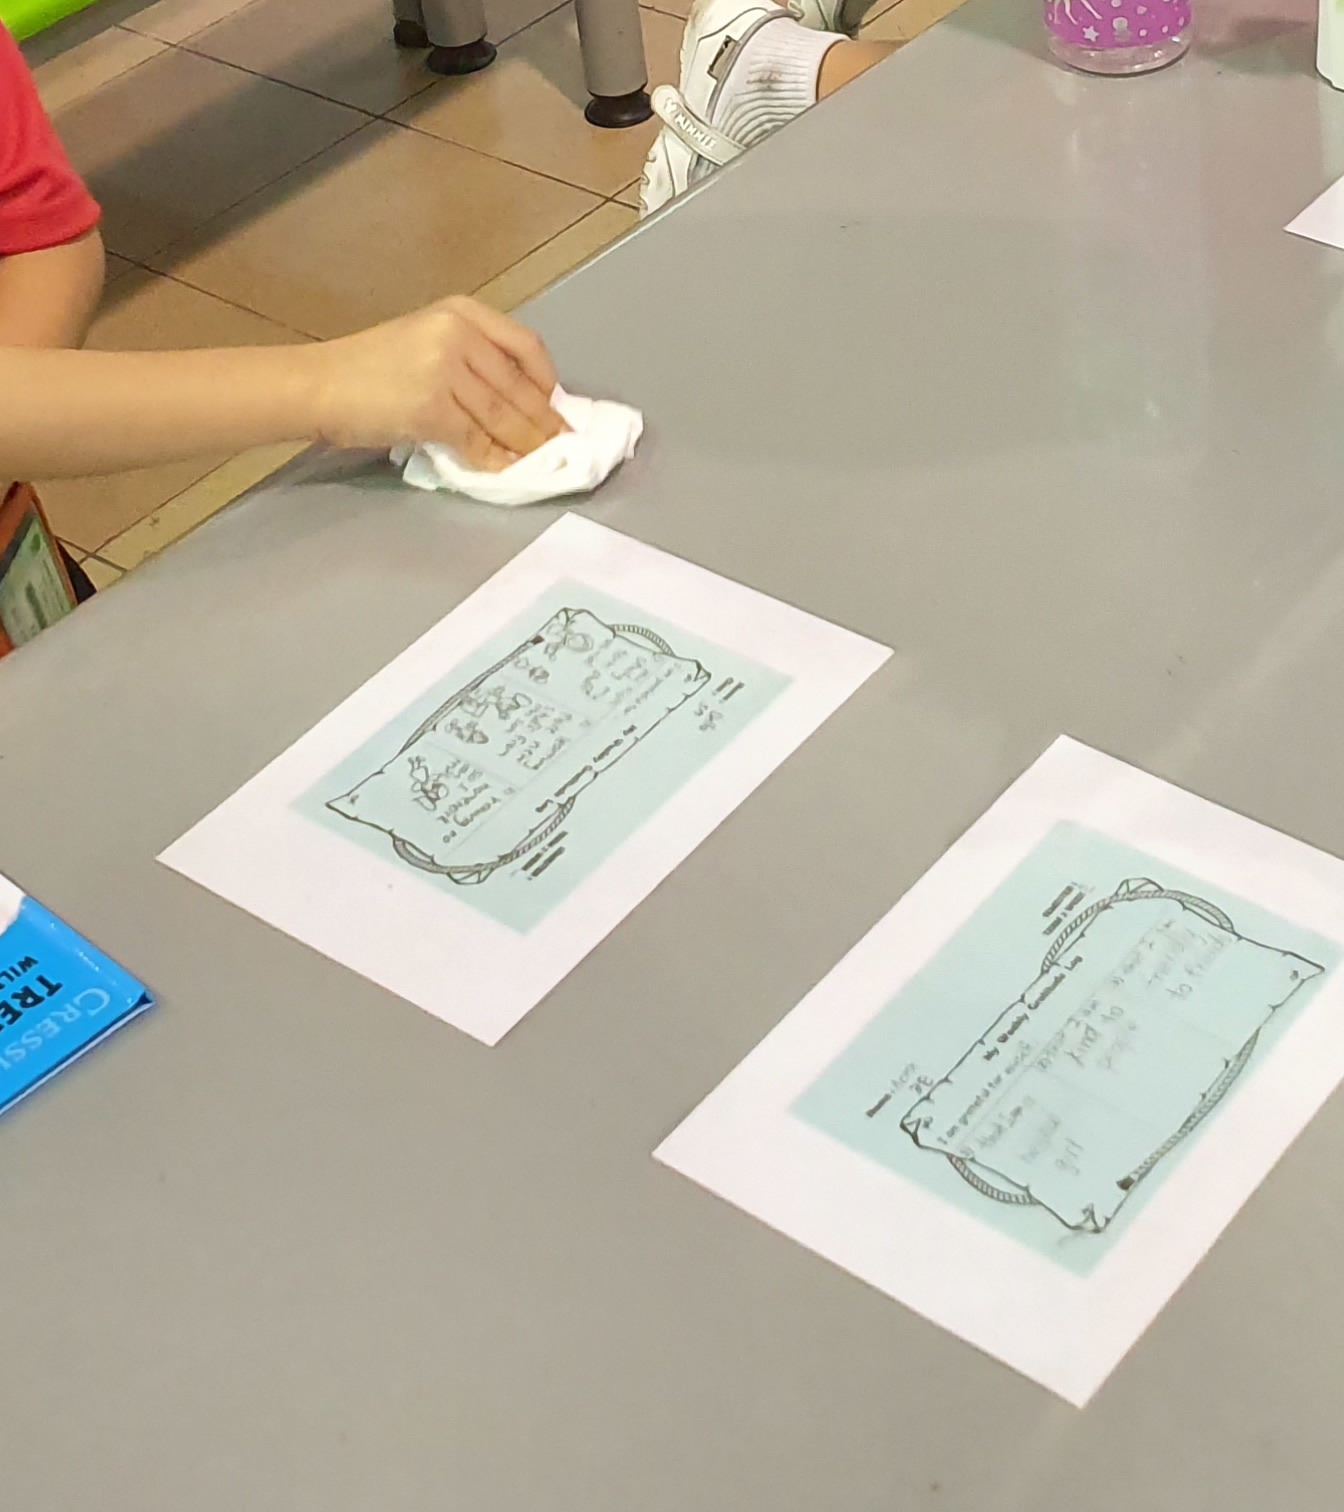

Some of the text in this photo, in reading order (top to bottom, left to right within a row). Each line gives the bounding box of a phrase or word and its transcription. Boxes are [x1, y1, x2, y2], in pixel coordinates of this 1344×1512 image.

[981, 954, 1083, 1061] My Weekly Gratitude Log
